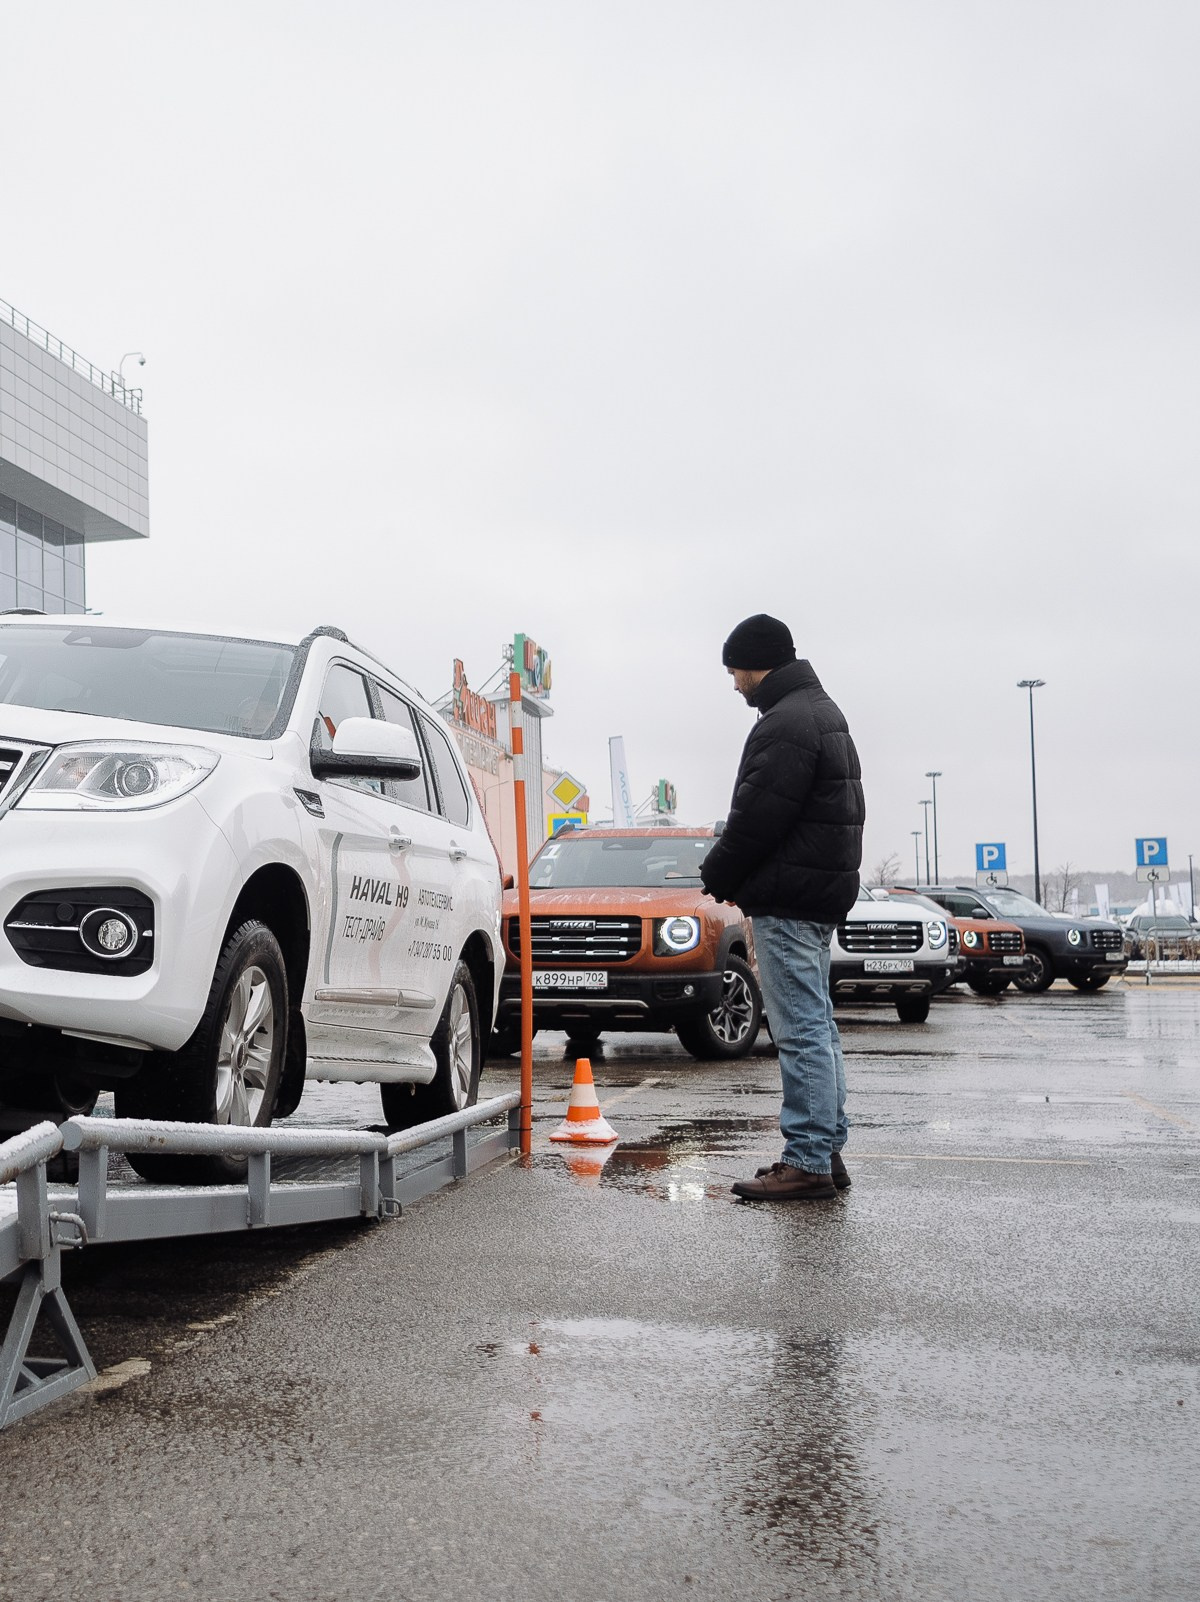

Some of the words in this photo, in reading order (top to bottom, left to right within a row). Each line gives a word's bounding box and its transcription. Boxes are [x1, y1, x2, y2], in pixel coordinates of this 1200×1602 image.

[982, 846, 999, 869] P
[1143, 841, 1160, 864] P
[350, 875, 392, 906] HAVAL
[395, 884, 409, 909] H9
[342, 916, 386, 944] ТЕСТ-ДРАЙВ
[443, 945, 453, 962] 00
[585, 972, 604, 983] 702
